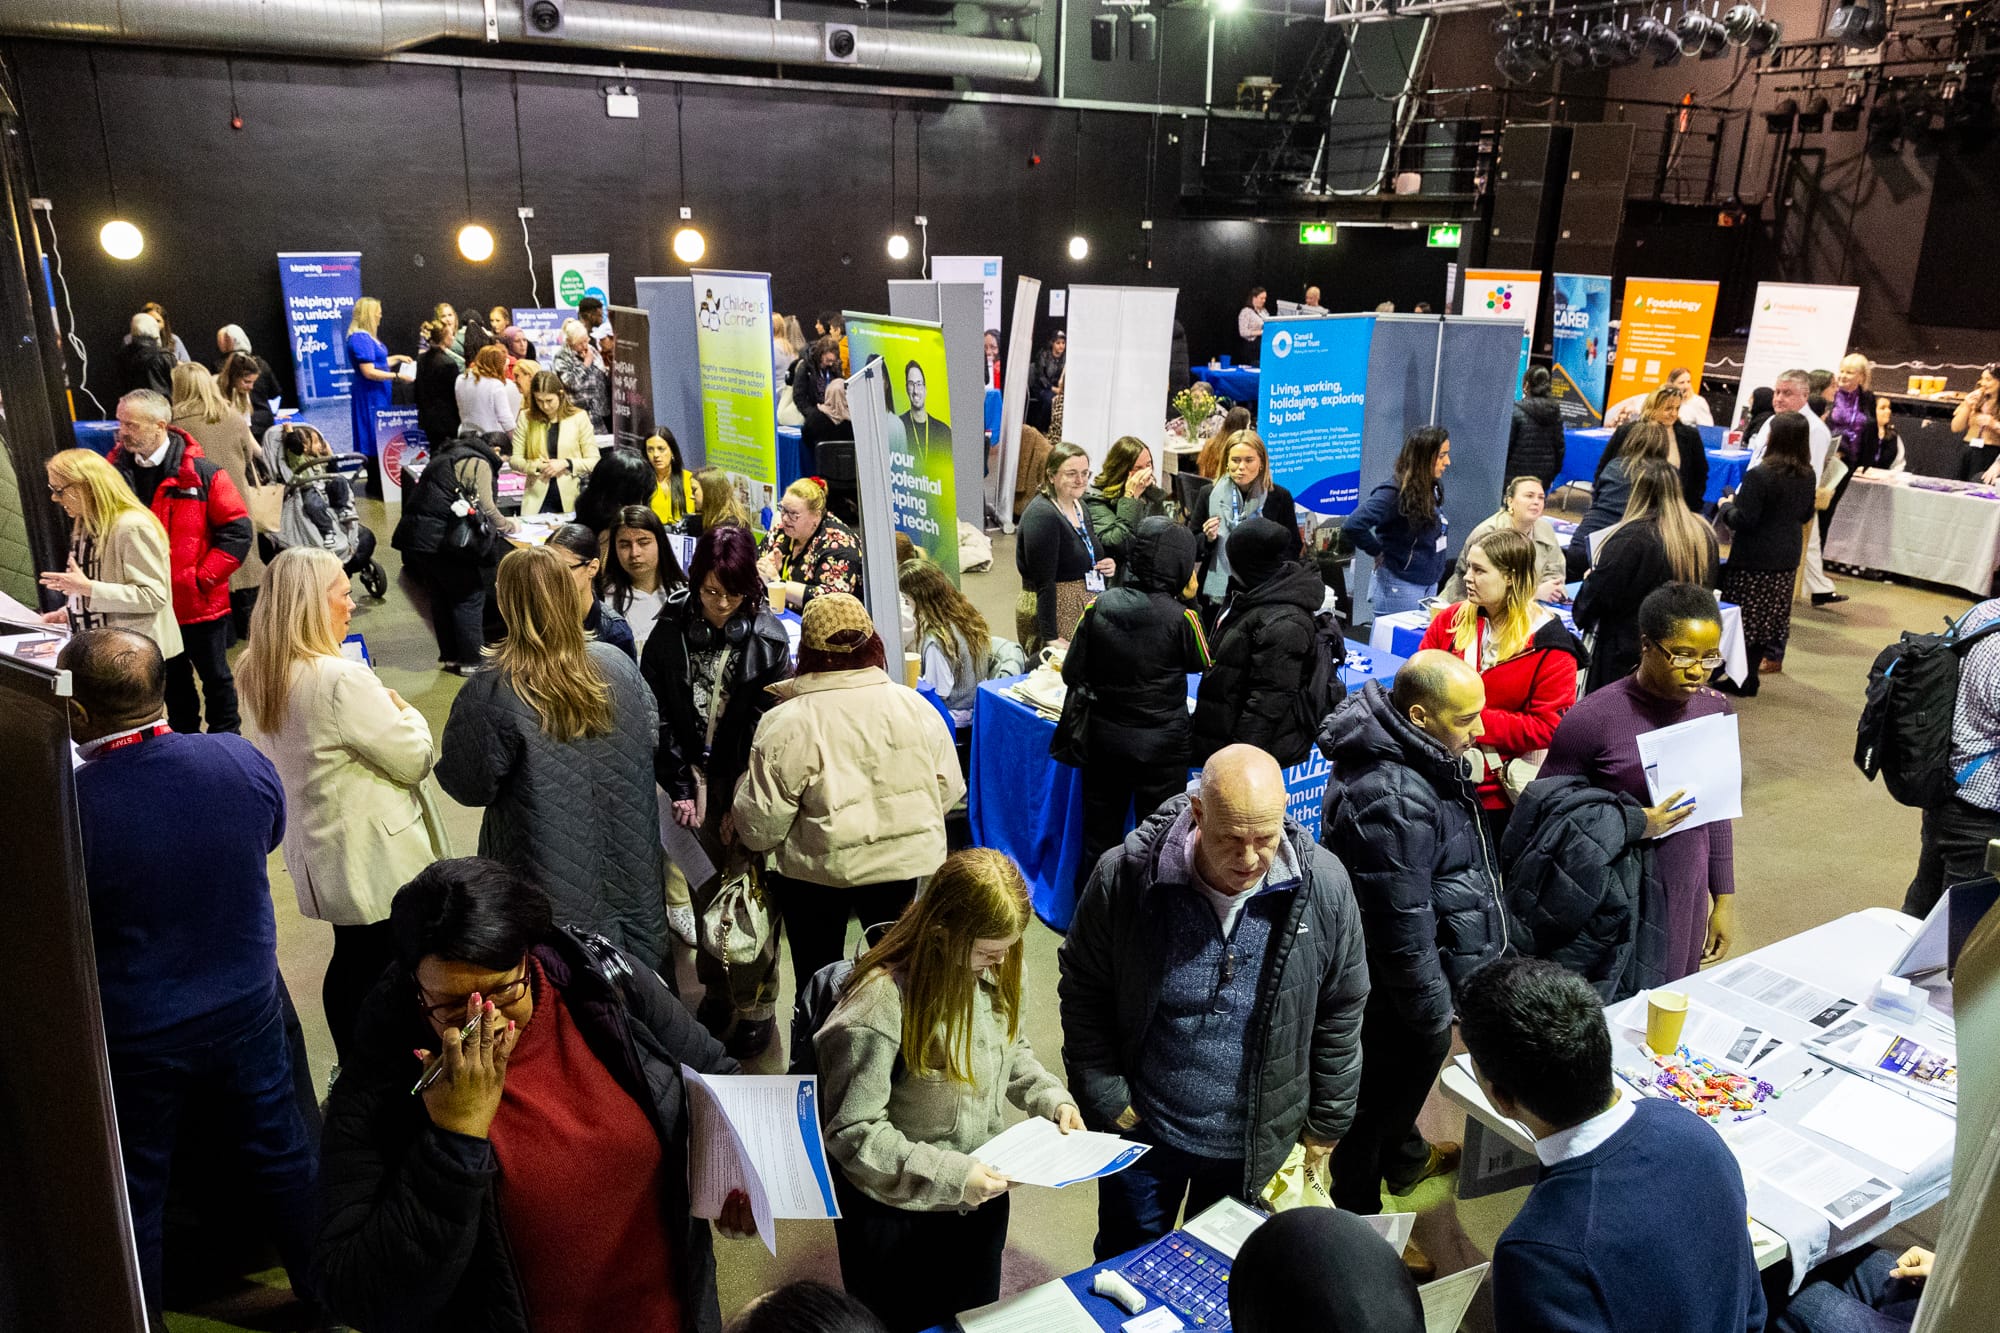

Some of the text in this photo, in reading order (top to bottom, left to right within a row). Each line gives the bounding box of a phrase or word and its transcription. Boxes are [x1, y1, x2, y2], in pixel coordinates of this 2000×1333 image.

[289, 296, 354, 309] Helping you
[1646, 297, 1702, 312] Foodology
[291, 309, 342, 321] to unlock
[724, 312, 757, 327] Corner
[1553, 310, 1590, 329] CARER
[293, 324, 318, 336] your
[296, 335, 328, 362] future
[1270, 381, 1342, 397] Living, working,
[1270, 392, 1364, 410] holidaying, exploring
[377, 409, 419, 418] Characterist
[1269, 410, 1305, 426] by boat
[889, 451, 915, 469] your
[892, 489, 927, 516] lping
[902, 513, 940, 536] reach
[110, 736, 133, 749] STAFF
[1305, 1166, 1315, 1183] We
